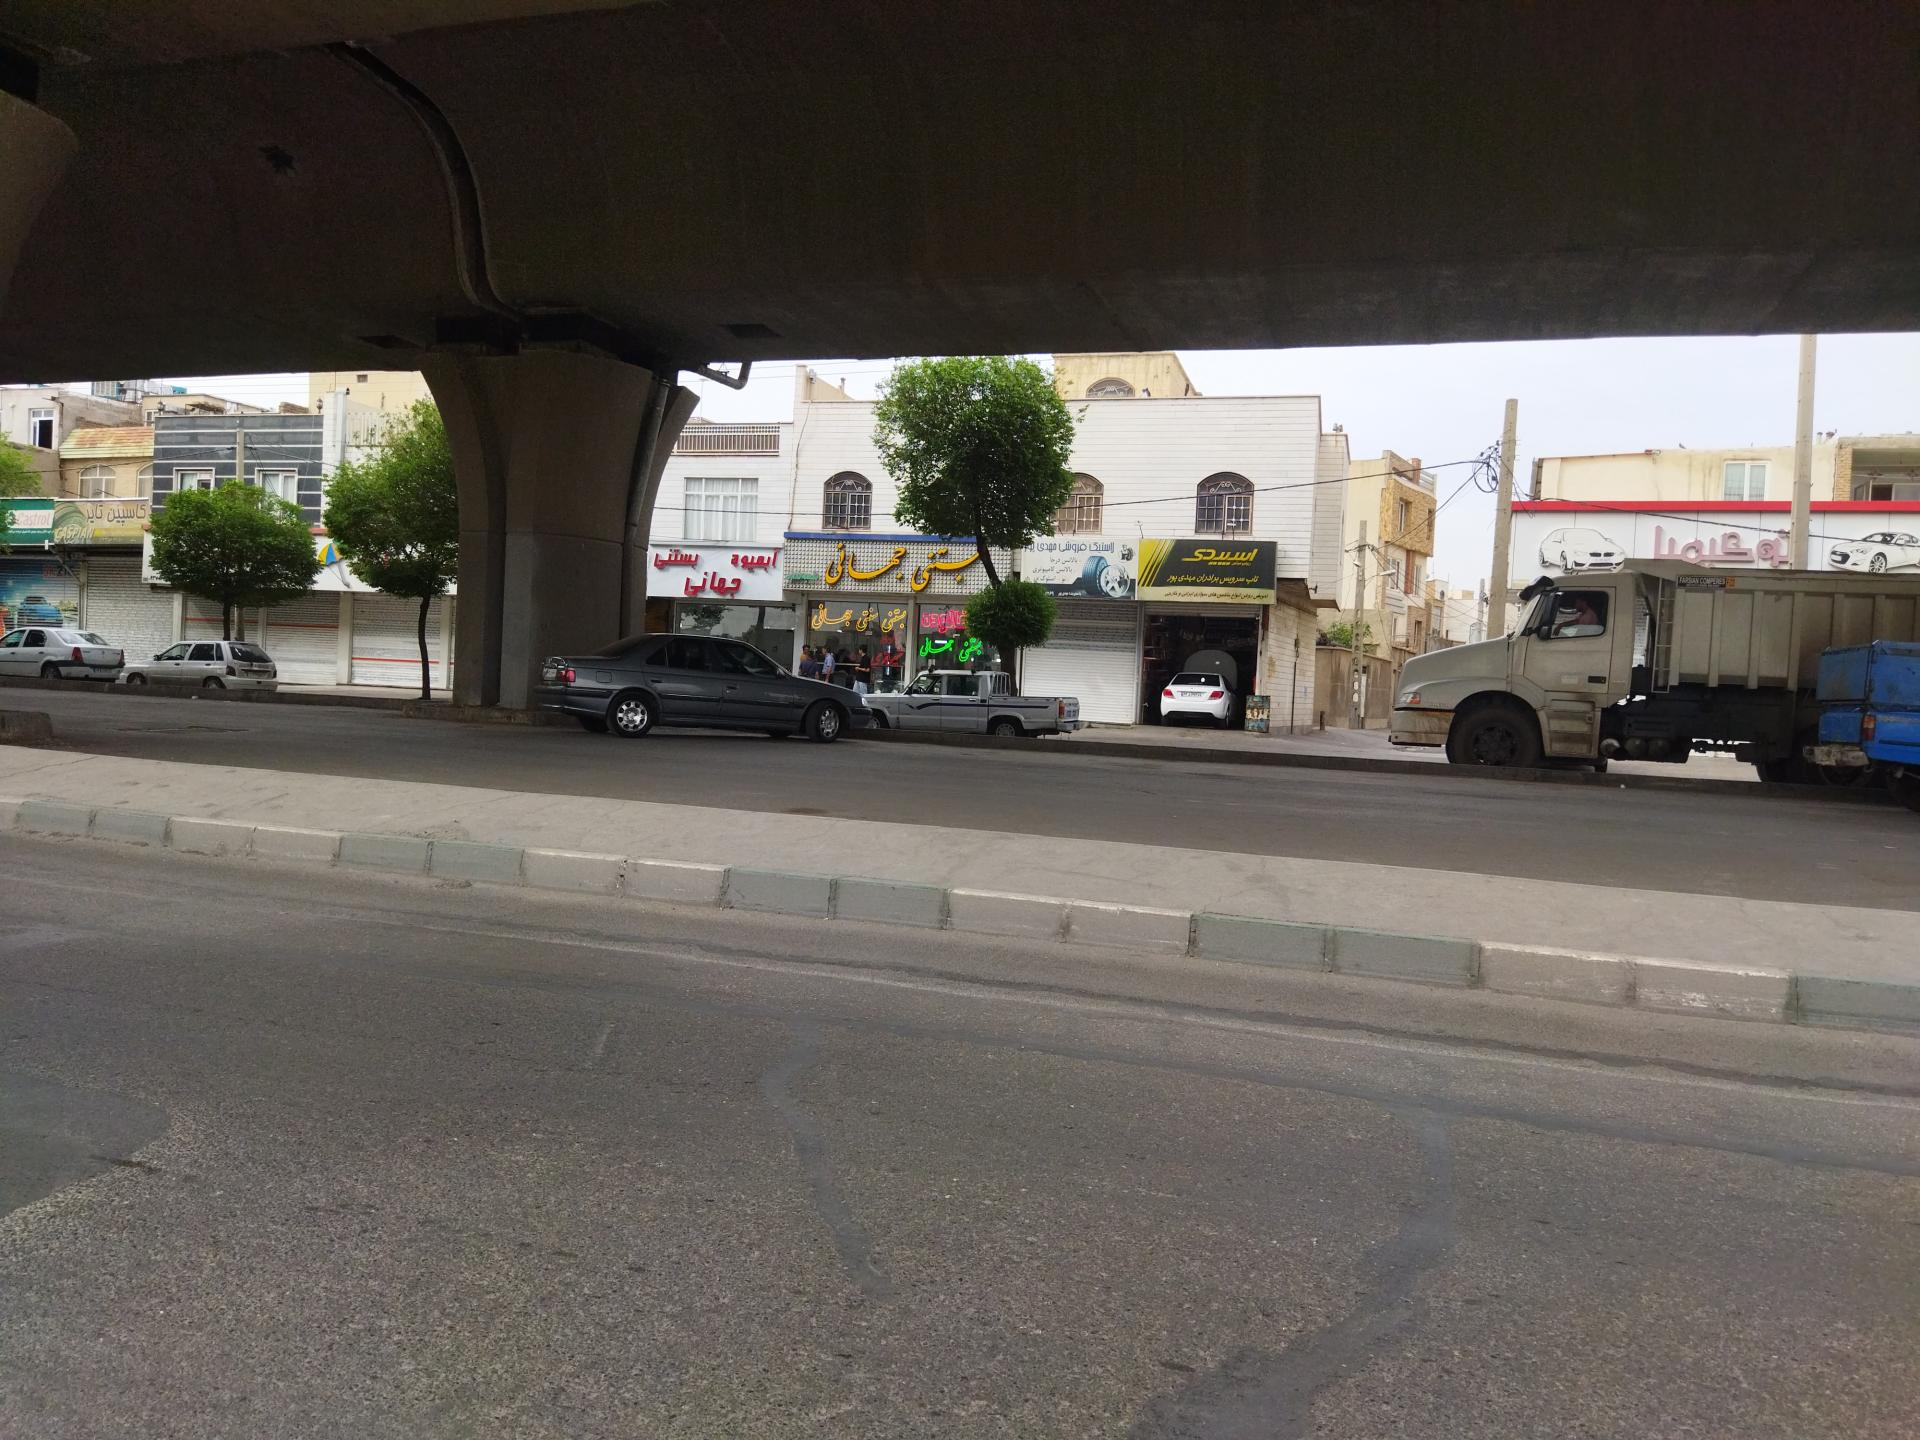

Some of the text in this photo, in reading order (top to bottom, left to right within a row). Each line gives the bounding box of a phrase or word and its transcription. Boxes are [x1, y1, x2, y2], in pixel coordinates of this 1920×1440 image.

[17, 511, 51, 527] Castrol
[86, 504, 147, 526] کاسپین تایر
[54, 527, 95, 541] CASPIAN
[1036, 541, 1057, 553] مهدی
[1059, 540, 1087, 554] فروشی
[1089, 541, 1115, 554] لاستیک
[653, 548, 700, 570] بستنی
[825, 543, 980, 592] بستنی جهانی
[684, 571, 742, 599] جهانی
[1166, 575, 1178, 584] پور
[1177, 574, 1196, 583] مهدی
[1197, 573, 1220, 584] برادران
[1219, 576, 1245, 585] سرویس
[811, 603, 853, 630] جهانی
[881, 607, 907, 633] بستنی
[919, 637, 955, 657] جهانی
[958, 636, 983, 663] بستنی
